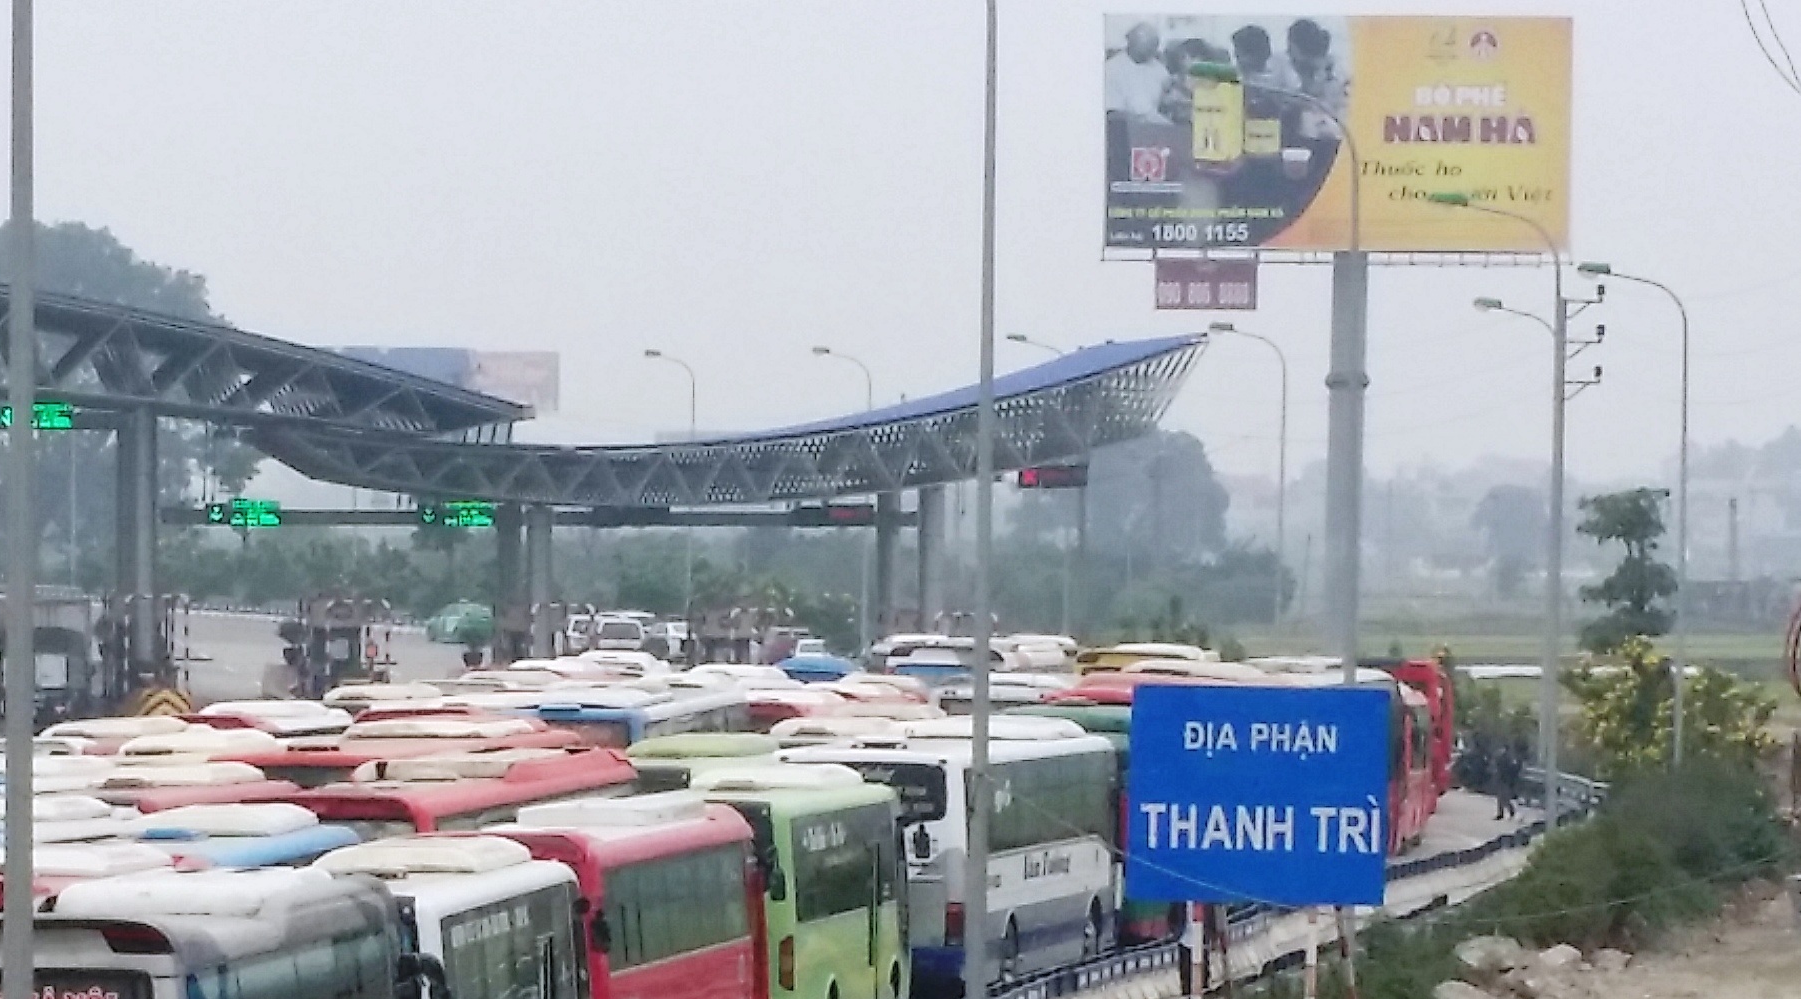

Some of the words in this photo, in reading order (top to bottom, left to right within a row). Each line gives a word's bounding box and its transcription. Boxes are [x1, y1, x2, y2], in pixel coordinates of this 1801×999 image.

[1383, 115, 1471, 142] NAM
[1480, 109, 1536, 143] HÀ
[1204, 223, 1249, 241] 1155
[1183, 720, 1237, 758] ĐỊA
[1250, 719, 1337, 760] PHẬN
[1140, 802, 1295, 851] THANH
[1310, 794, 1382, 854] TRÌ
